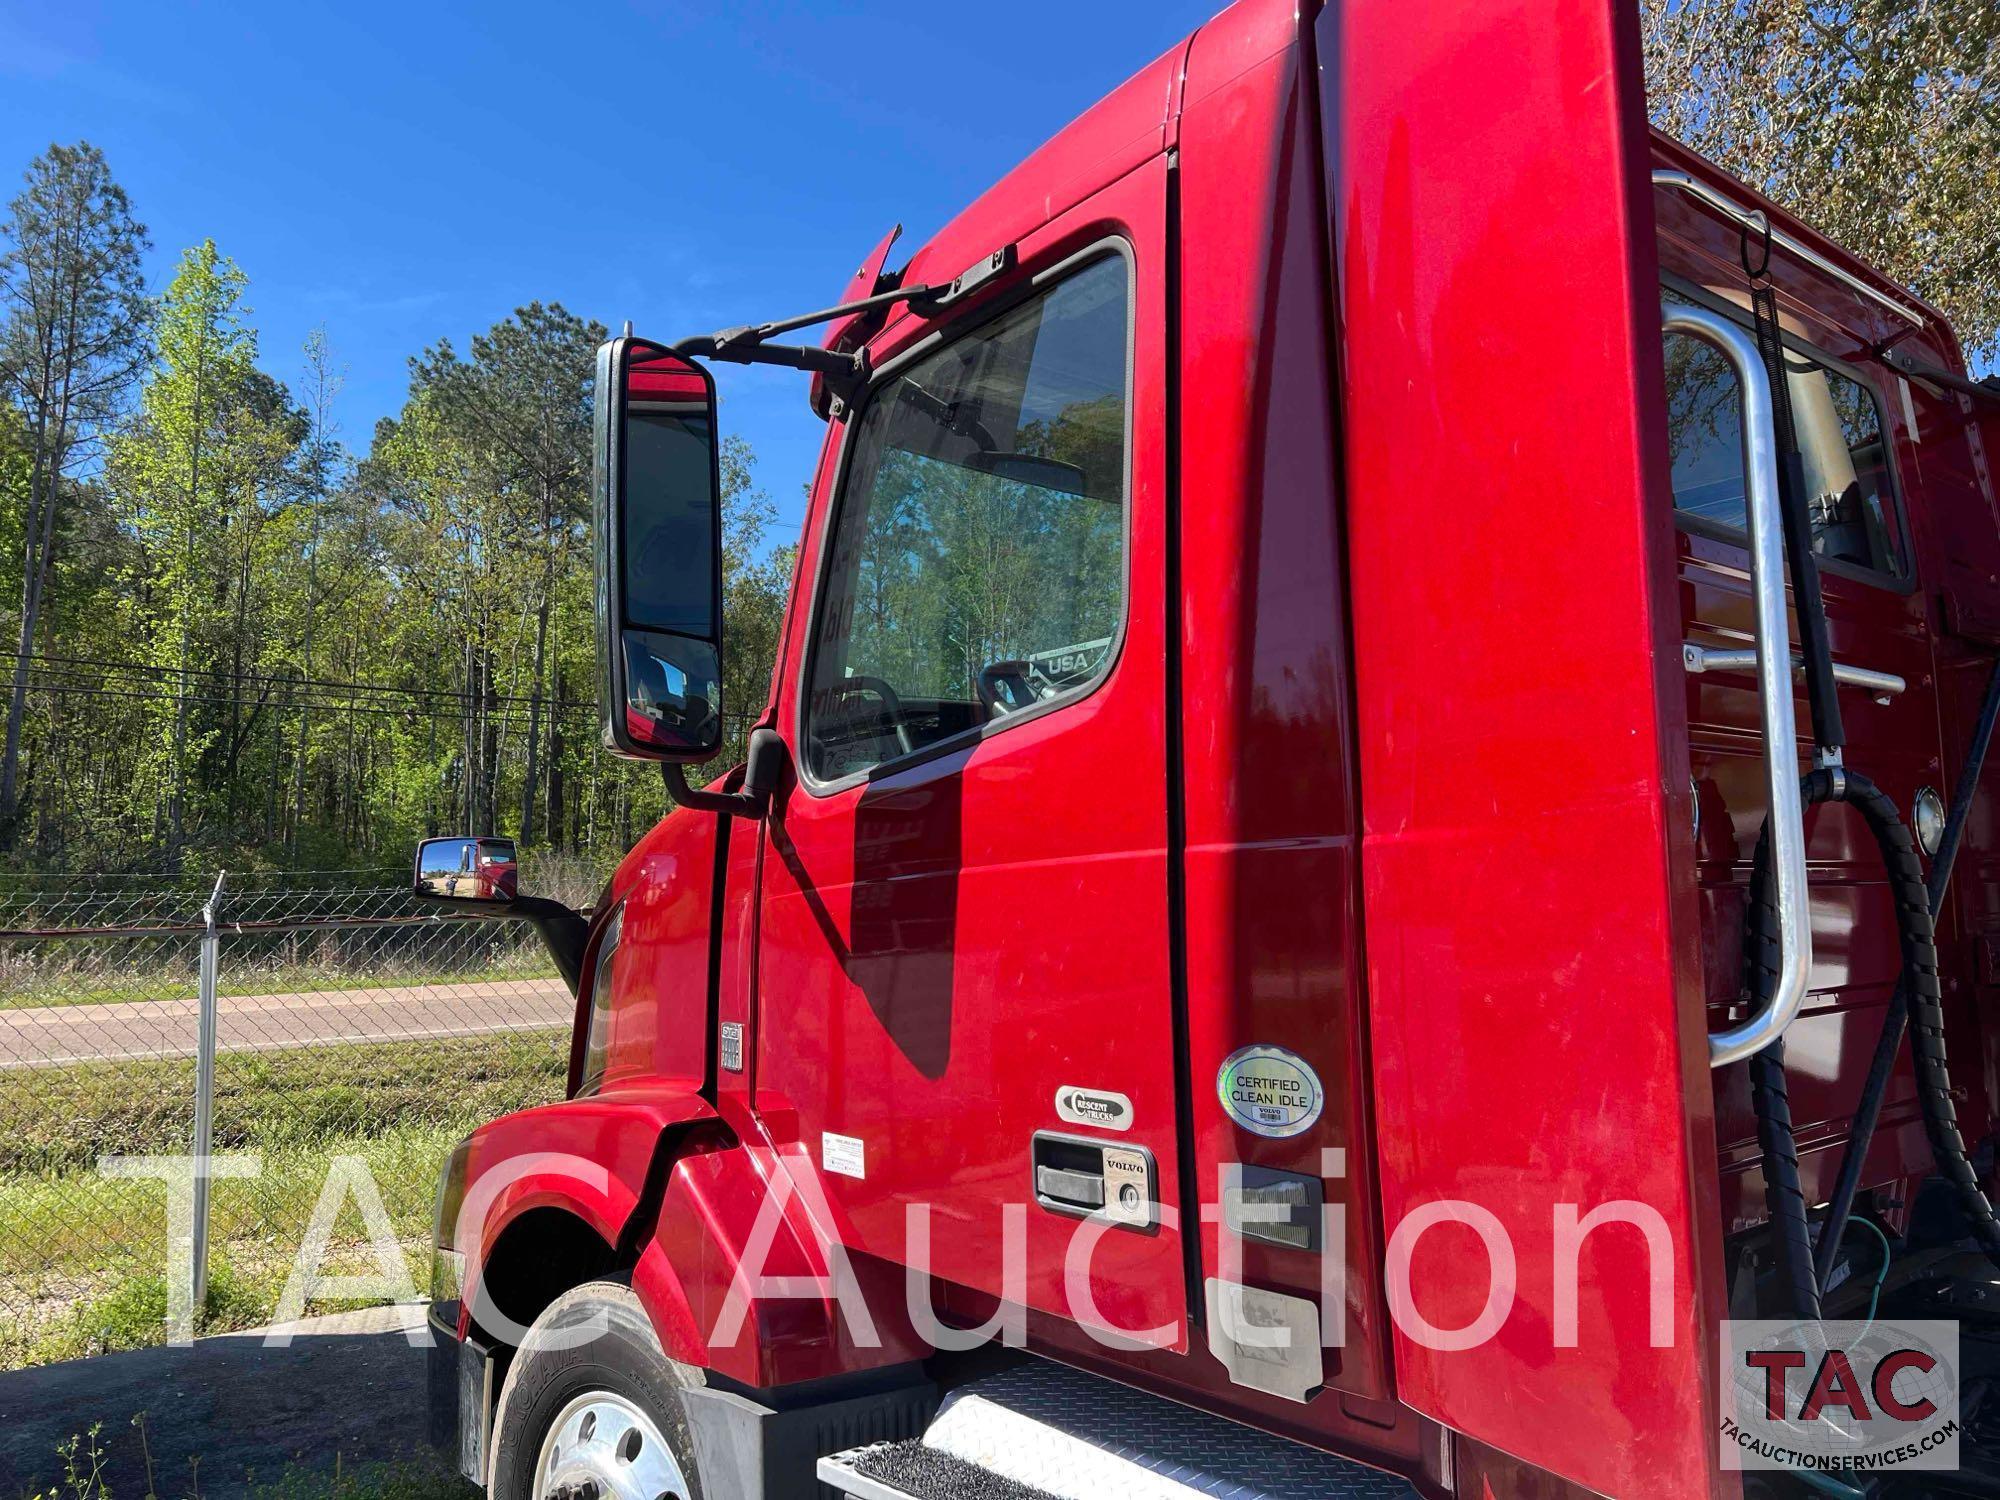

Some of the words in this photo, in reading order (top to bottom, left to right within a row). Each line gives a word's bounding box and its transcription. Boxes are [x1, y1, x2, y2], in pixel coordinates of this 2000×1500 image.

[1049, 653, 1088, 674] USA
[1236, 1075, 1301, 1092] CERTIFIED
[1231, 1090, 1274, 1105] CLEAN
[1279, 1094, 1308, 1108] IDLE
[1086, 1109, 1115, 1122] TRUCKS
[1258, 1107, 1281, 1115] VOLVO
[1106, 1159, 1144, 1174] VOLVO
